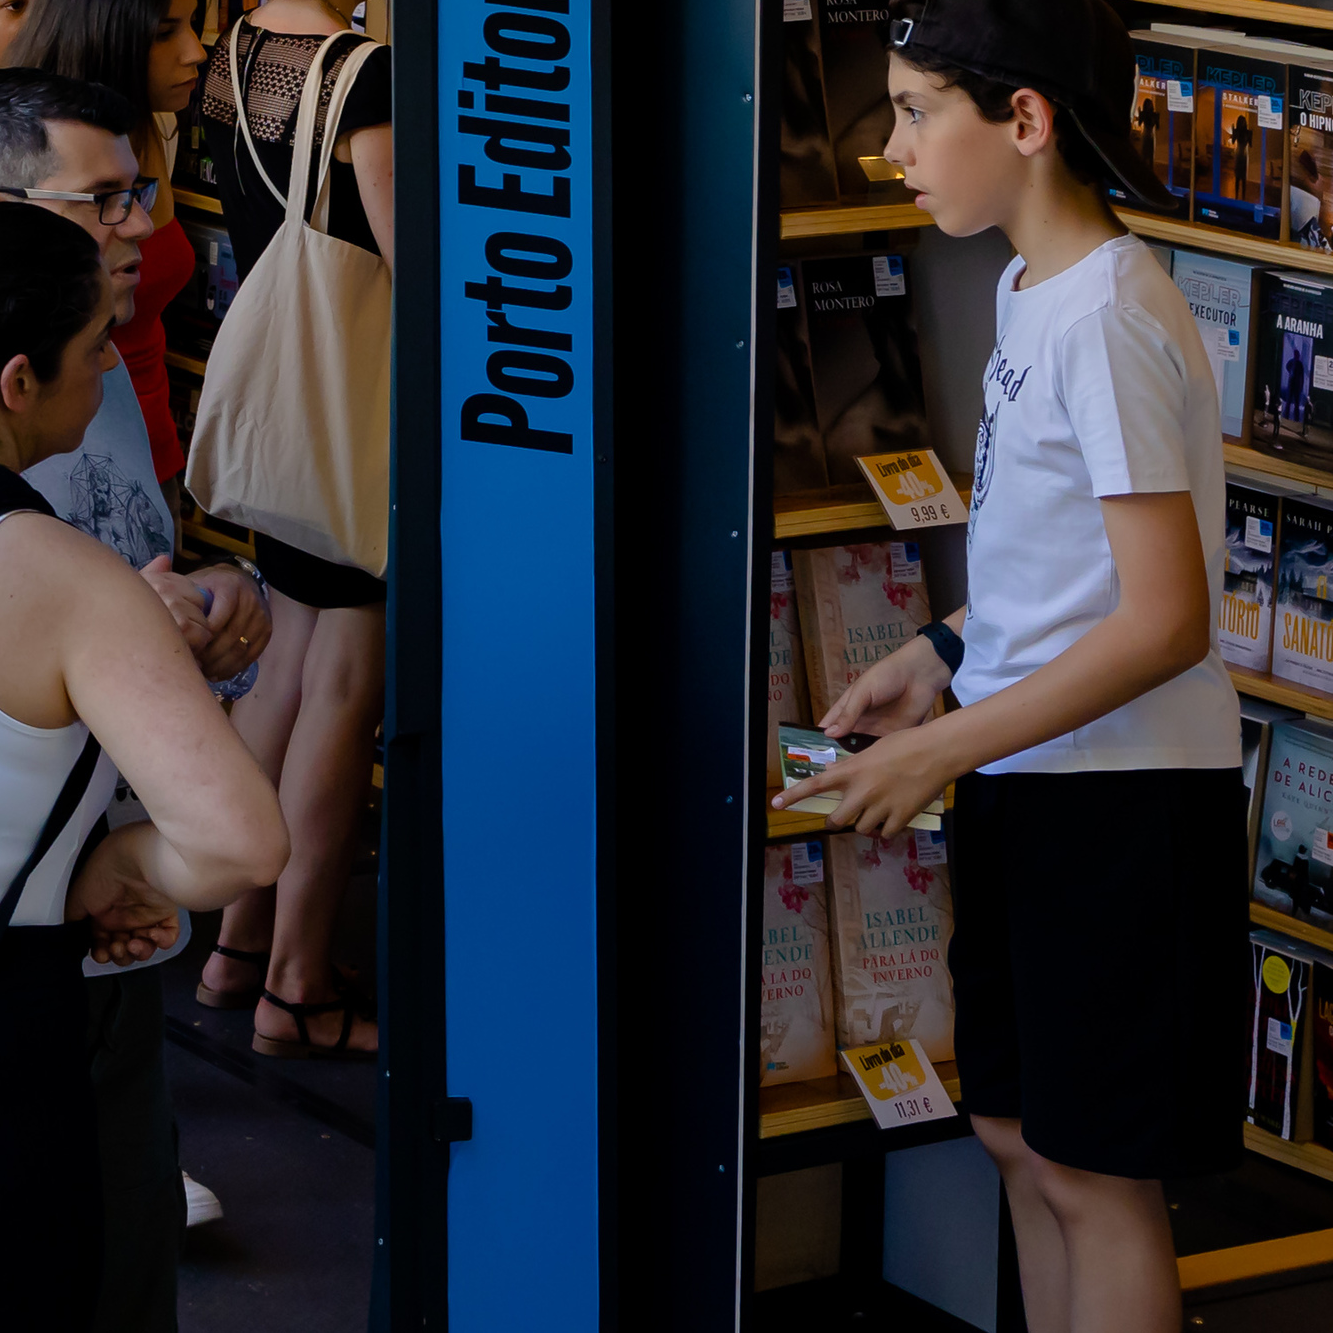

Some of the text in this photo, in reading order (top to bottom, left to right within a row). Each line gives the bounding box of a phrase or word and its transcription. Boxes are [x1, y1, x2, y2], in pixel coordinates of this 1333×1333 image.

[828, 9, 889, 24] MONTERO
[1206, 66, 1278, 95] KEPLER
[1300, 111, 1306, 126] O
[812, 281, 843, 295] ROSA
[815, 296, 875, 312] MONTERO
[1276, 314, 1323, 339] A ARANHA
[460, 230, 574, 454] Porto
[875, 459, 898, 478] Livro
[911, 503, 951, 524] 9,99 €
[1229, 498, 1270, 518] PEARSE
[1286, 513, 1322, 532] SARAH
[847, 621, 908, 645] ISABEL
[1283, 757, 1291, 769] A
[1274, 770, 1292, 787] DE
[866, 906, 929, 929] ISABEL
[858, 924, 941, 950] ALLENDE
[862, 948, 939, 970] PARA LÁ DO
[873, 966, 934, 985] INVERNO
[859, 1051, 883, 1071] Livro
[894, 1096, 933, 1119] 11,31 €
